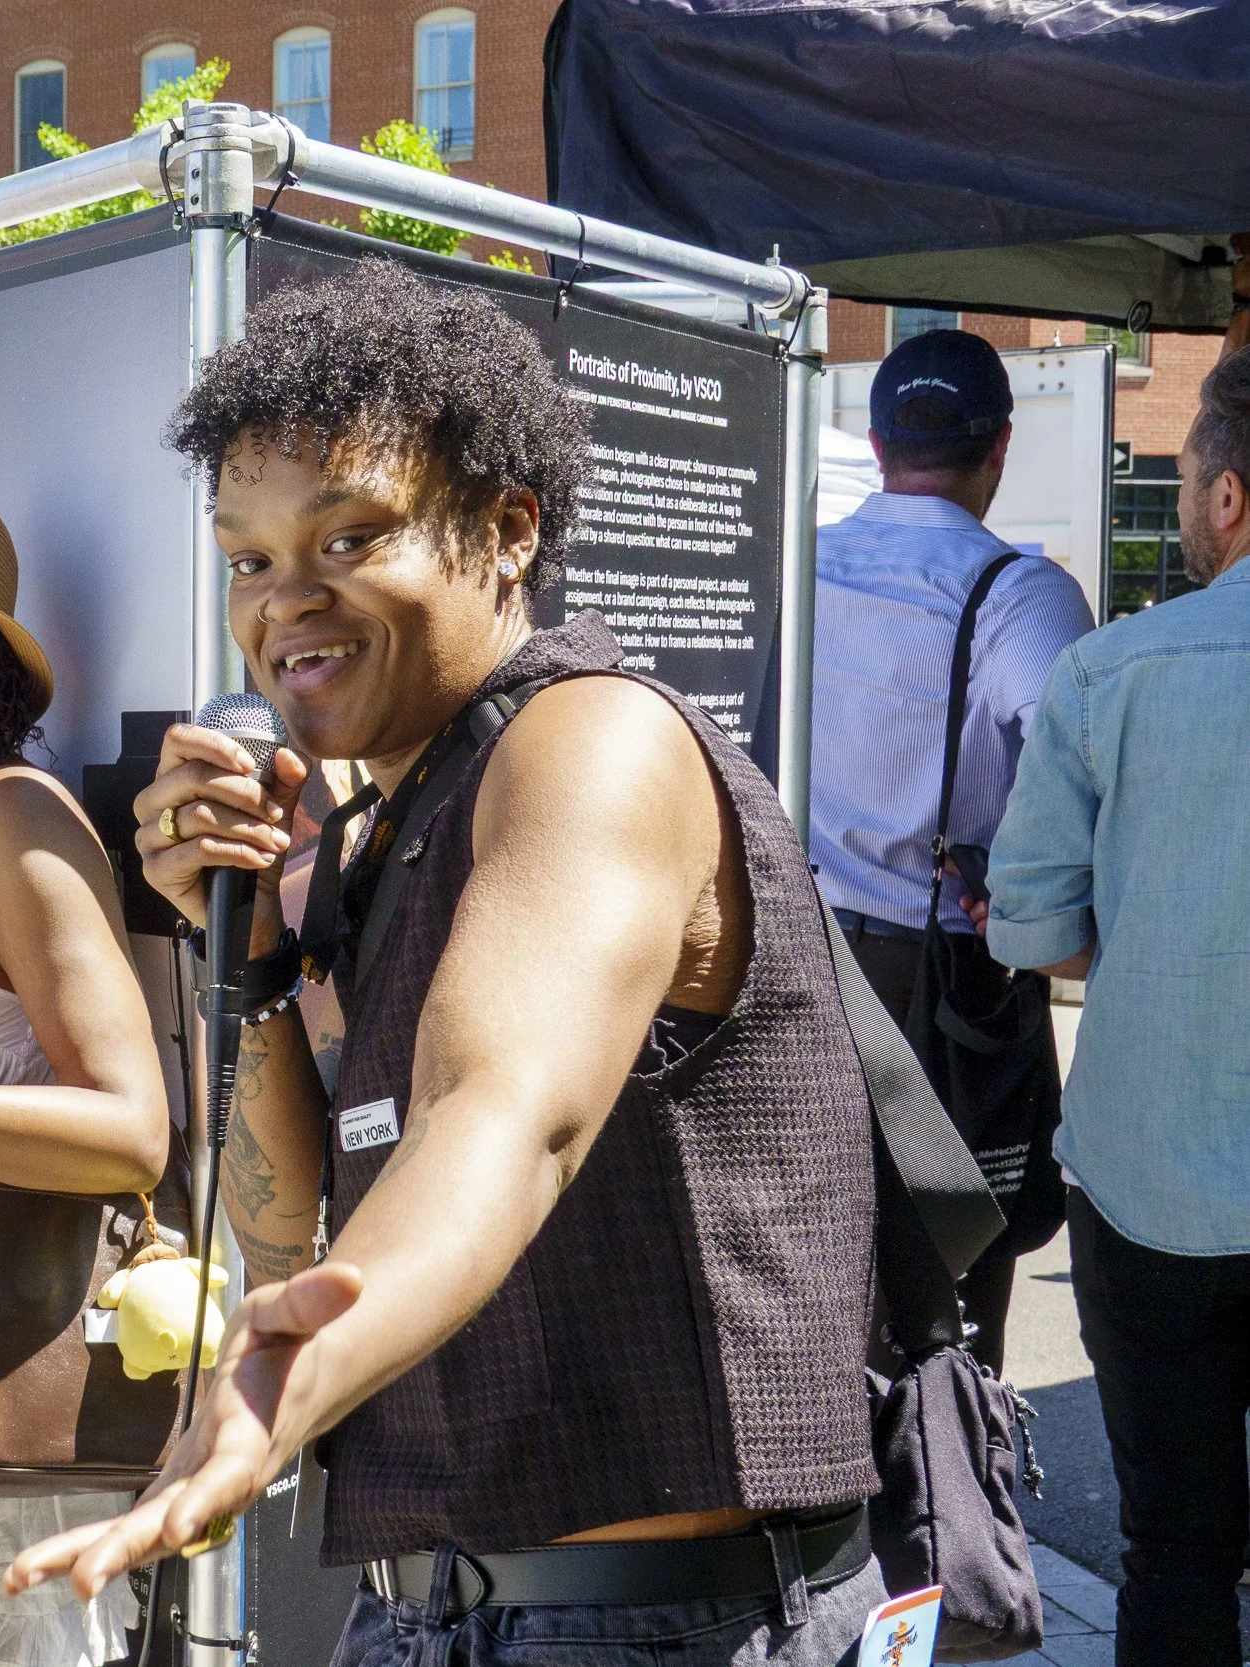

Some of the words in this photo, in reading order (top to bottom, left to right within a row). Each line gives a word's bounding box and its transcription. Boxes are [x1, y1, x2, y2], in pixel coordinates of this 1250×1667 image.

[570, 348, 616, 380] Portraits
[618, 361, 630, 383] of
[631, 363, 679, 397] Proximity,
[681, 374, 692, 400] by
[694, 376, 721, 401] VSCO
[912, 378, 931, 388] York
[615, 448, 634, 465] began
[635, 451, 648, 465] with
[649, 455, 653, 466] a
[654, 454, 668, 468] clear
[693, 460, 707, 474] show
[708, 465, 715, 476] us
[716, 465, 728, 478] your
[620, 469, 664, 489] photographers
[665, 476, 683, 490] chose
[683, 478, 689, 491] to
[690, 480, 705, 493] make
[731, 484, 741, 498] Not
[614, 492, 622, 502] or
[655, 494, 665, 508] but
[666, 499, 673, 509] as
[674, 499, 678, 509] a
[679, 497, 707, 513] deliberate
[724, 505, 735, 518] way
[735, 504, 741, 517] to
[603, 510, 615, 523] and
[616, 512, 642, 526] connect
[643, 513, 656, 527] with
[657, 515, 666, 528] the
[668, 519, 687, 531] person
[688, 518, 693, 531] in
[695, 518, 708, 532] front
[709, 519, 715, 532] of
[715, 520, 724, 534] the
[738, 523, 752, 537] Often
[590, 526, 597, 544] by
[598, 531, 603, 539] a
[604, 529, 625, 544] shared
[656, 535, 670, 549] what
[671, 539, 681, 550] can
[683, 540, 691, 550] we
[692, 540, 710, 552] create
[566, 567, 593, 583] Whether
[595, 570, 604, 584] the
[606, 570, 619, 585] final
[620, 571, 639, 589] image
[640, 573, 646, 587] is
[647, 575, 660, 589] part
[661, 574, 668, 588] of
[669, 579, 672, 588] a
[673, 577, 698, 591] personal
[720, 582, 727, 591] an
[728, 579, 748, 593] editorial
[565, 589, 604, 606] assignment,
[605, 594, 611, 605] or
[612, 594, 616, 605] a
[617, 592, 635, 606] brand
[636, 594, 668, 611] campaign,
[669, 596, 683, 608] each
[685, 596, 705, 611] reflects
[706, 597, 715, 610] the
[617, 612, 627, 626] the
[628, 613, 648, 629] weight
[649, 613, 657, 627] of
[657, 614, 672, 628] their
[701, 616, 719, 629] Where
[720, 617, 726, 629] to
[622, 633, 644, 647] shutter.
[645, 634, 660, 647] How
[661, 635, 667, 648] to
[669, 634, 686, 648] frame
[687, 638, 690, 647] a
[725, 636, 737, 649] How
[738, 640, 741, 649] a
[742, 636, 753, 649] shift
[700, 693, 718, 709] images
[720, 695, 725, 706] as
[726, 693, 737, 707] part
[738, 692, 744, 706] of
[345, 1130, 363, 1148] NEW
[364, 1122, 393, 1142] YORK
